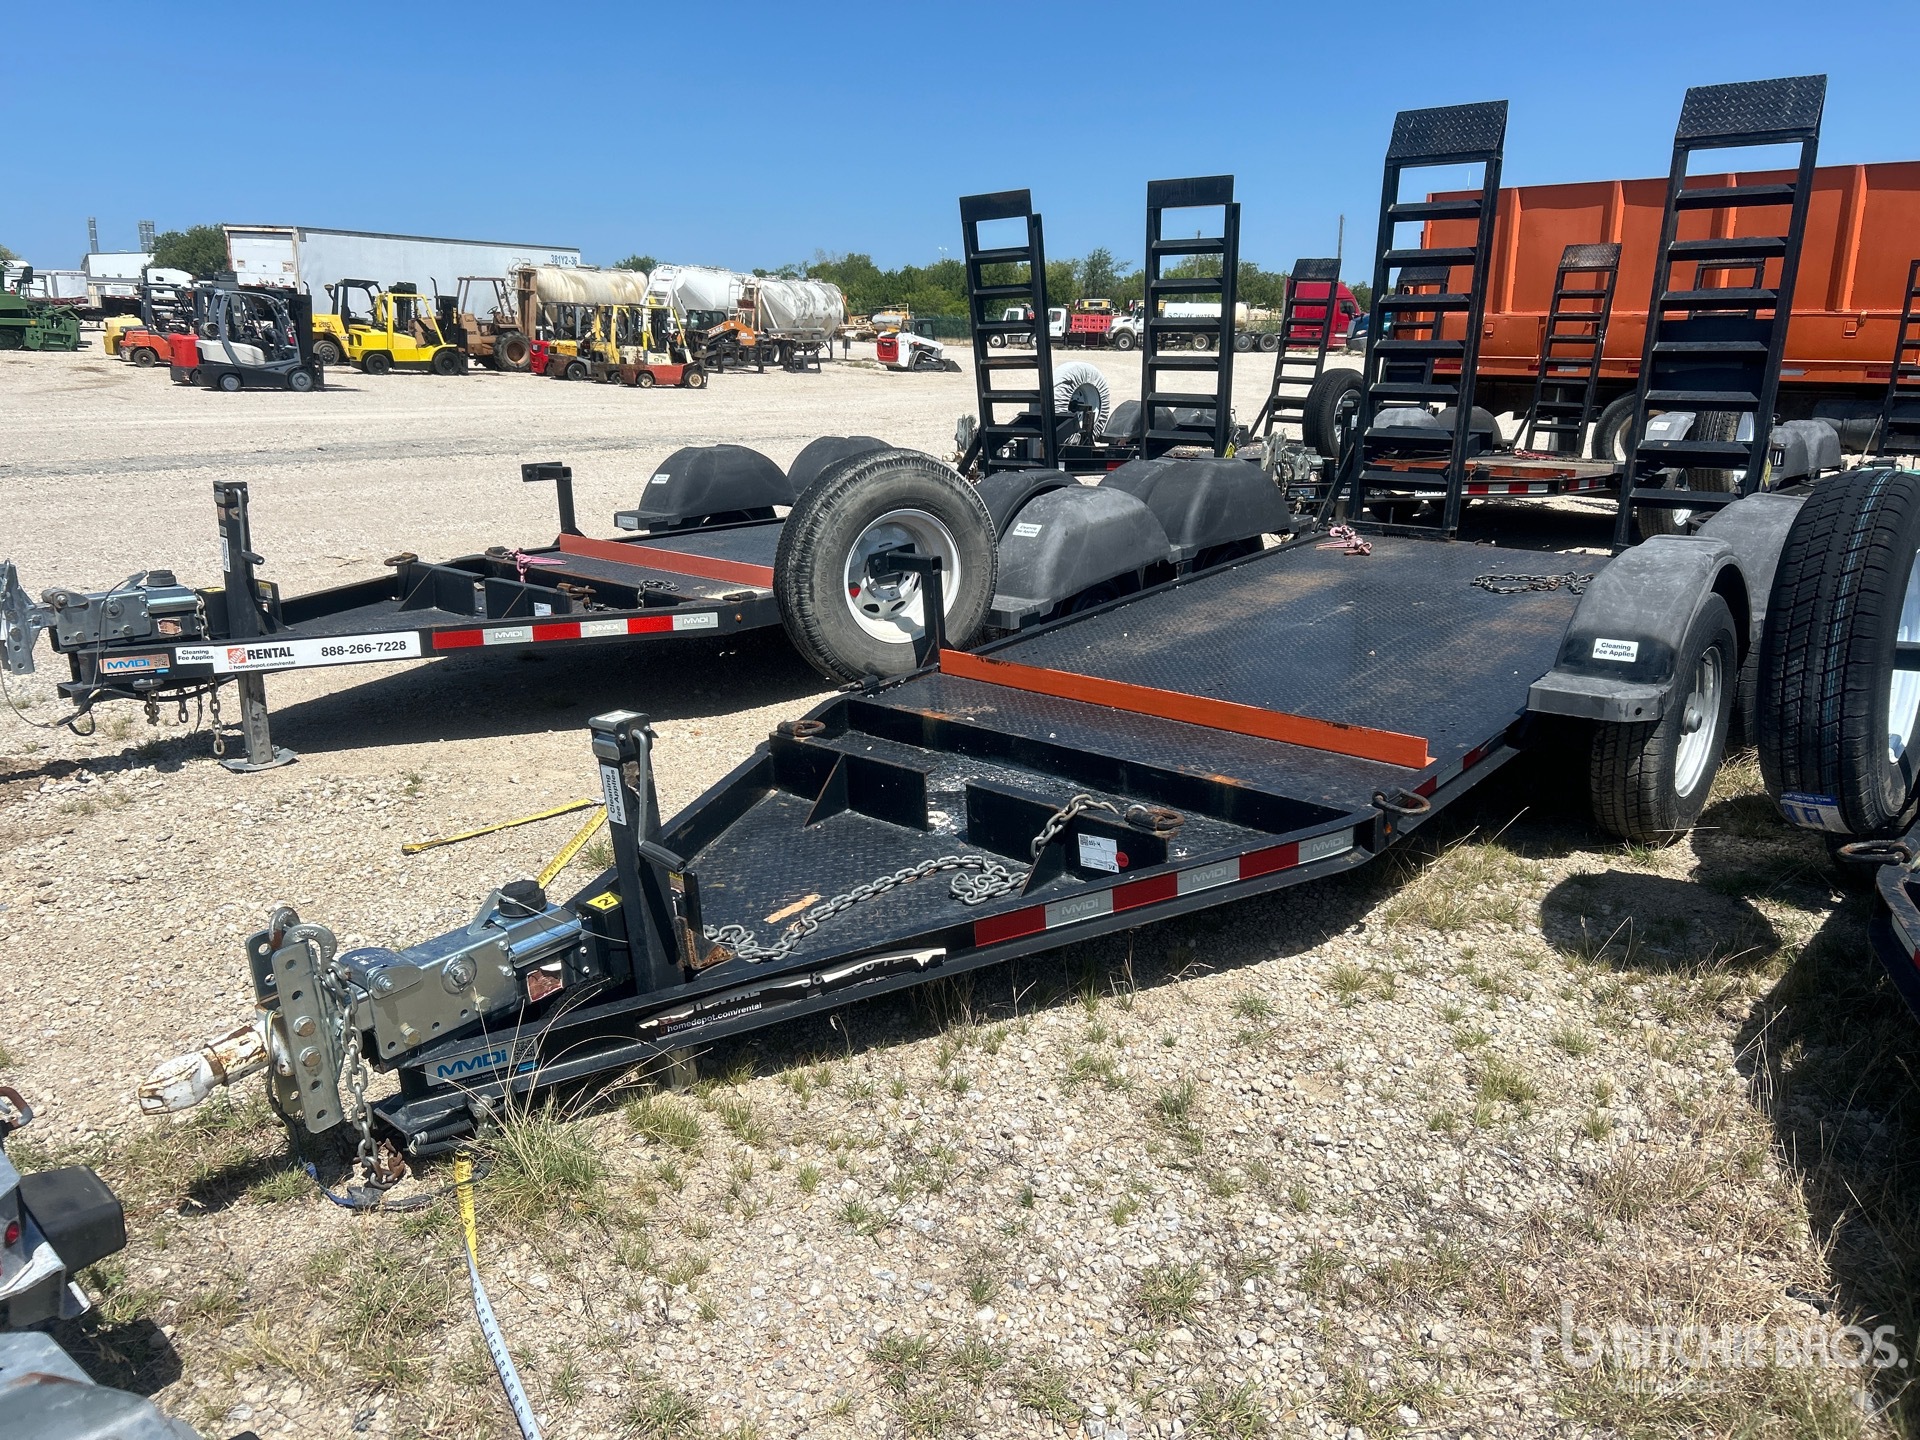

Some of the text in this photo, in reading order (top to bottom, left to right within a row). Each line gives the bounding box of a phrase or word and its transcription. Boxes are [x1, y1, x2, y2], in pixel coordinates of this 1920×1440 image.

[246, 646, 295, 661] RENTAL
[320, 640, 407, 658] 888-266-7228
[1601, 642, 1631, 651] Cleaning
[1608, 649, 1635, 658] Applies
[233, 659, 296, 671] homedepot.com/rental
[605, 774, 616, 814] Cleaning
[610, 769, 620, 804] Applies
[667, 1001, 763, 1033] homedepot.com/rental
